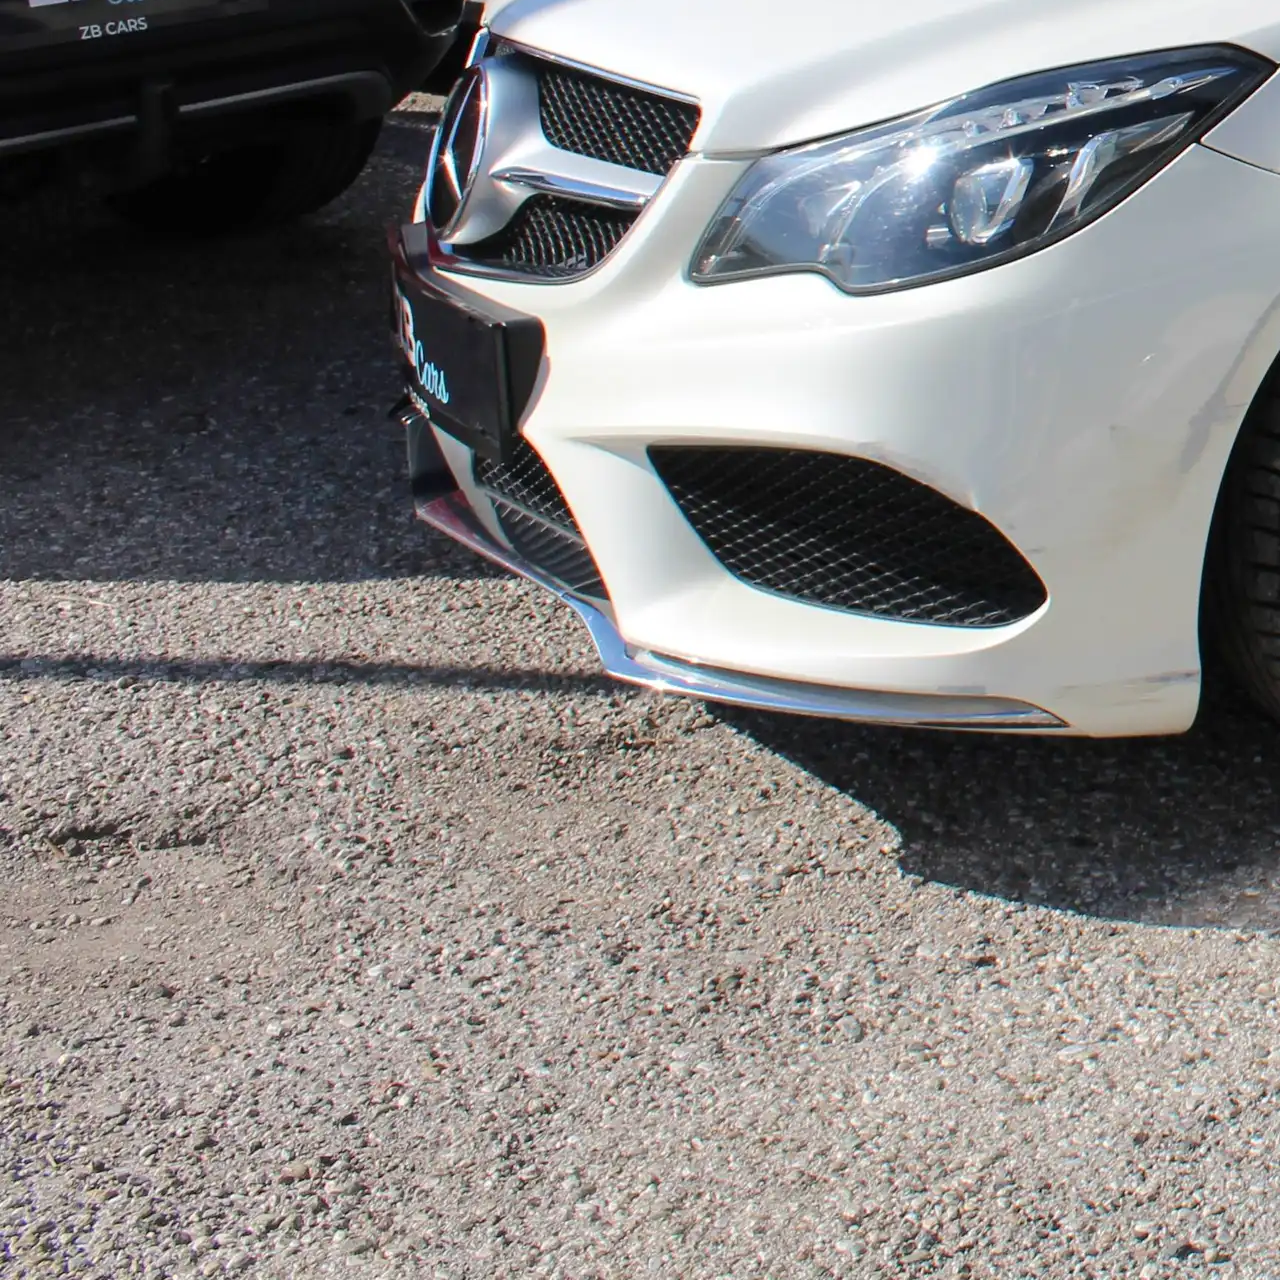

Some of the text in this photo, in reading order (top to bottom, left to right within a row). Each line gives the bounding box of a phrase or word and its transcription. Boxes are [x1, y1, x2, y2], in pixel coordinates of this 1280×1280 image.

[79, 17, 148, 39] ZB CARS
[399, 294, 416, 367] B
[415, 340, 449, 404] Cars
